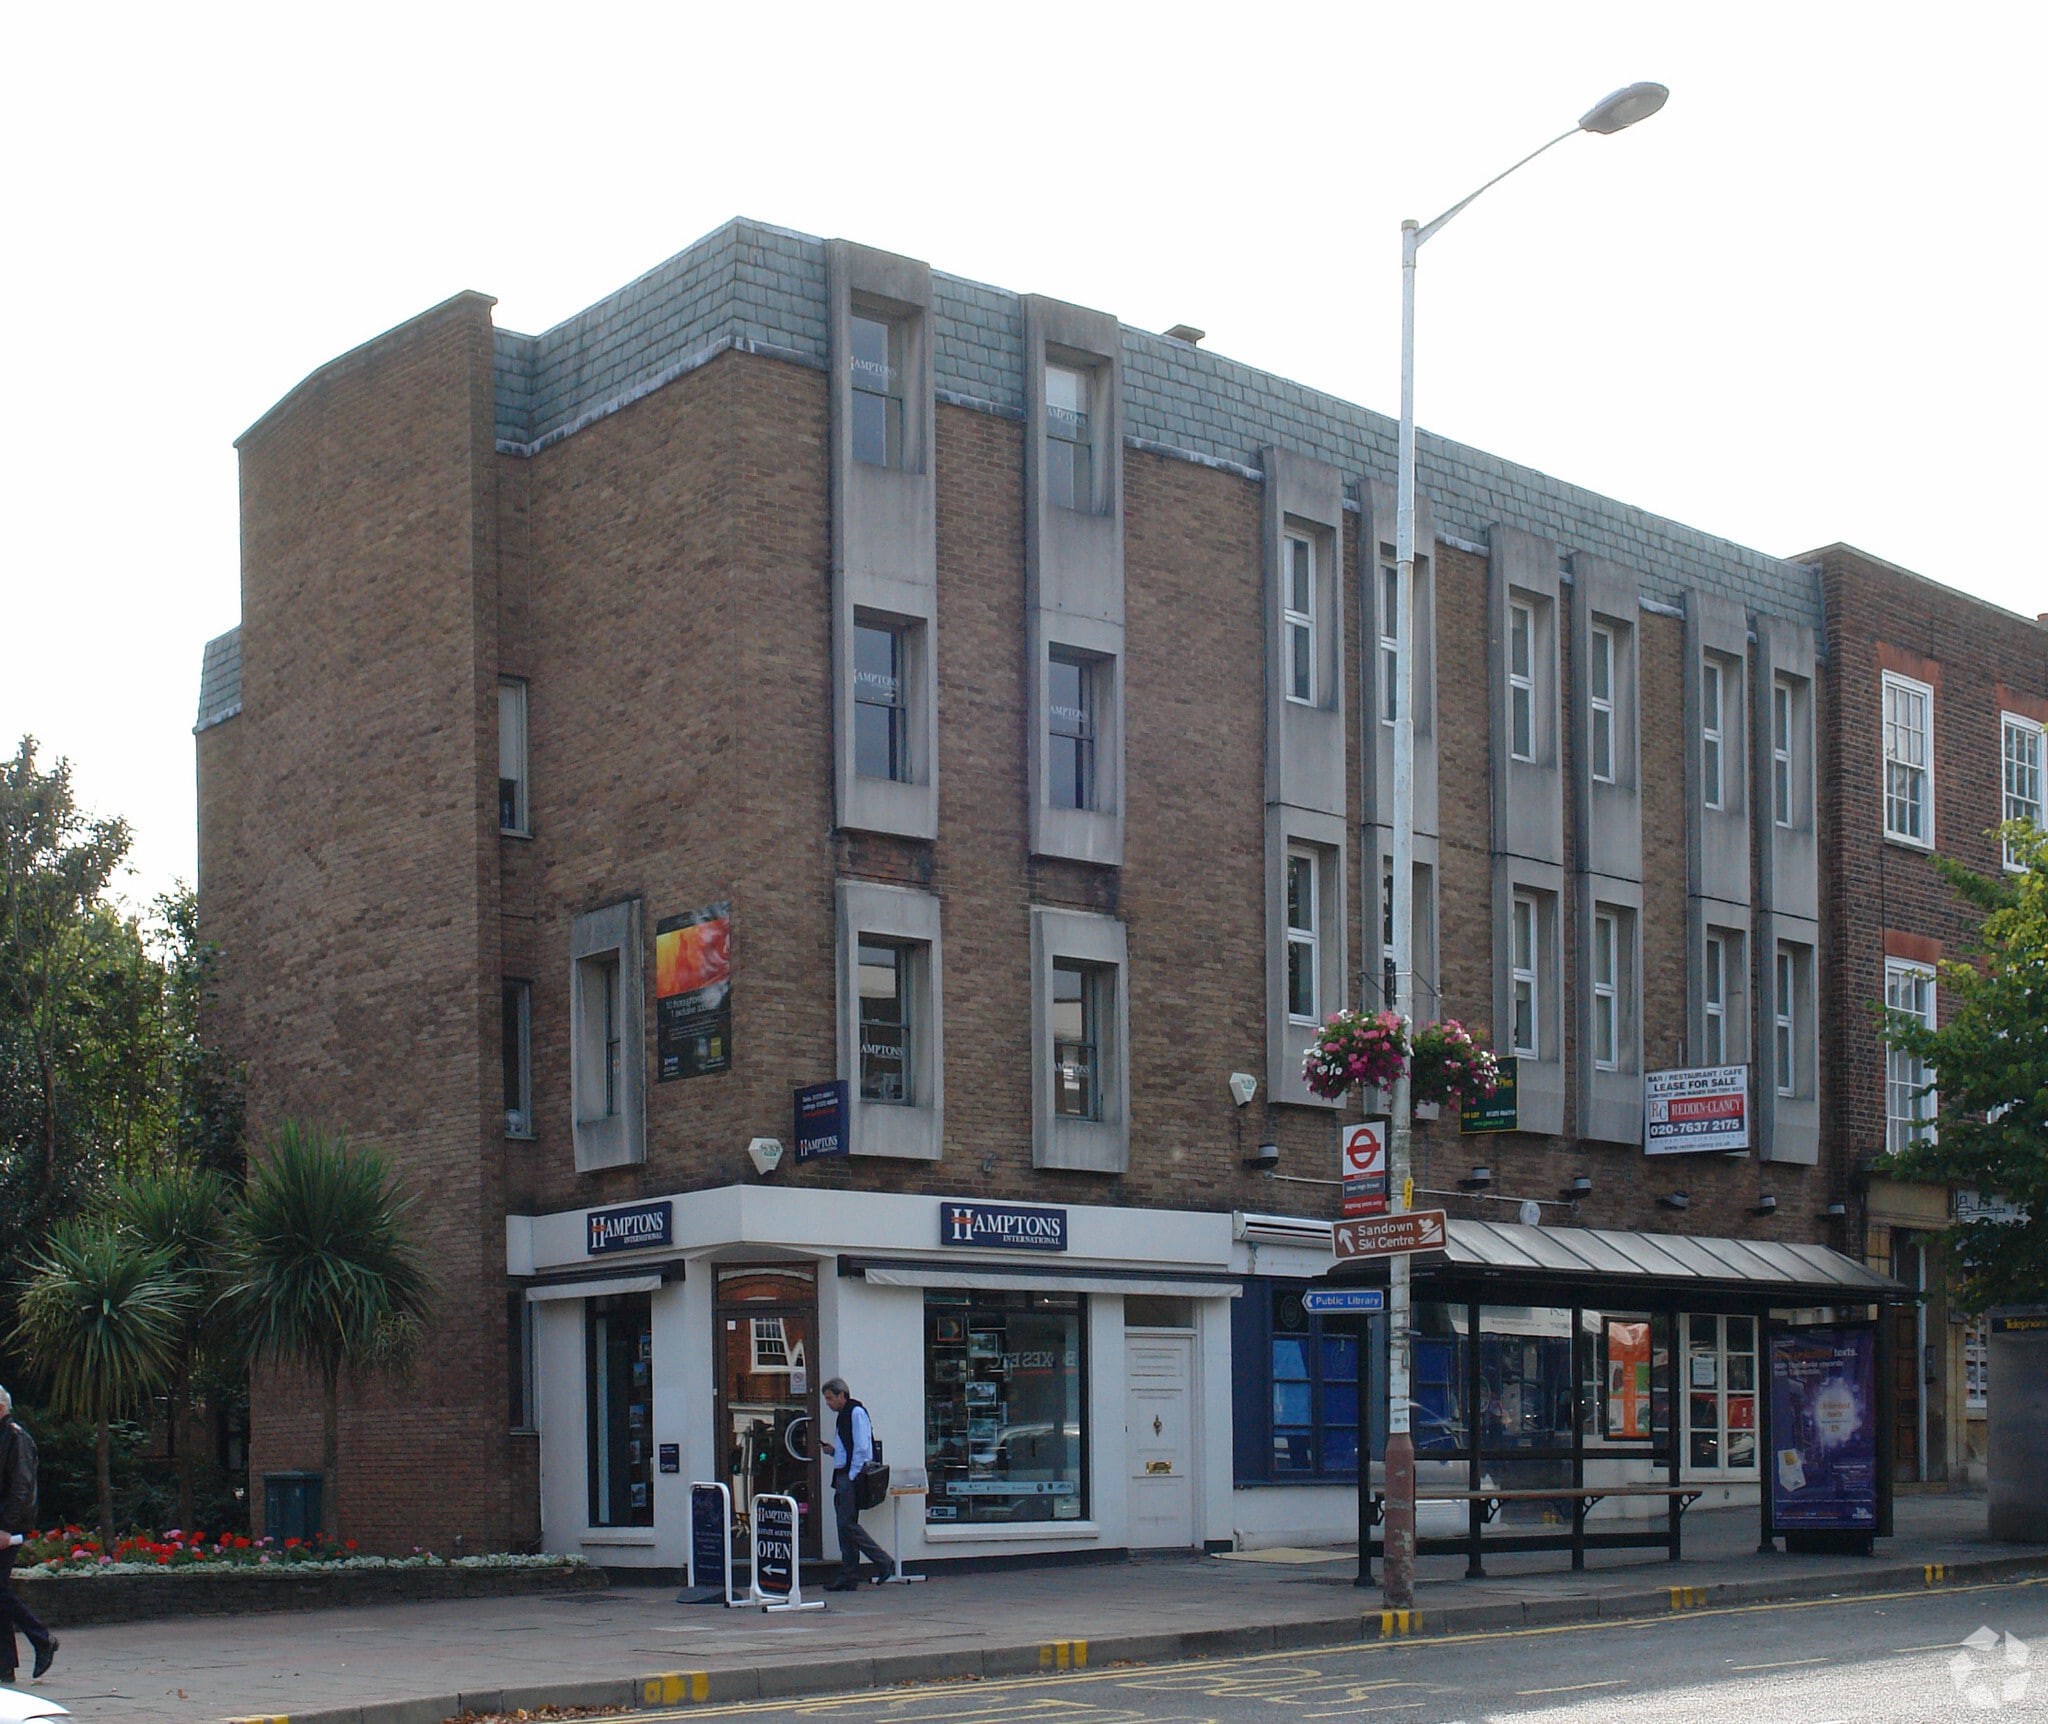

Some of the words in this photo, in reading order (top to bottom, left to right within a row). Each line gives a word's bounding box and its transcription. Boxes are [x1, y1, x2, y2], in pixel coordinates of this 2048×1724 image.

[1046, 407, 1087, 425] AMPTONS
[1050, 704, 1088, 721] AMPTONS
[860, 1043, 903, 1056] AMPTONS
[1669, 1070, 1717, 1081] RESTAURANT
[1723, 1068, 1743, 1077] CAFE
[1654, 1081, 1685, 1092] LEASE
[1689, 1079, 1708, 1089] FOR
[1711, 1077, 1737, 1087] SALE
[1671, 1099, 1740, 1116] REDDIN-CLANCY
[1651, 1121, 1710, 1136] 020-7637
[1711, 1119, 1740, 1132] 2175
[800, 1135, 838, 1157] HAMPTONS
[591, 1212, 664, 1249] HAMPTONS
[951, 1208, 1061, 1240] HAMPTONS
[1357, 1222, 1413, 1237] Sandown
[1003, 1234, 1060, 1245] INTERNATIONAL
[1358, 1238, 1376, 1250] Ski
[1378, 1235, 1415, 1248] Centre
[1315, 1296, 1344, 1305] Public
[1347, 1296, 1379, 1306] Library
[758, 1507, 792, 1522] HAMPTONS
[757, 1540, 792, 1560] OPEN
